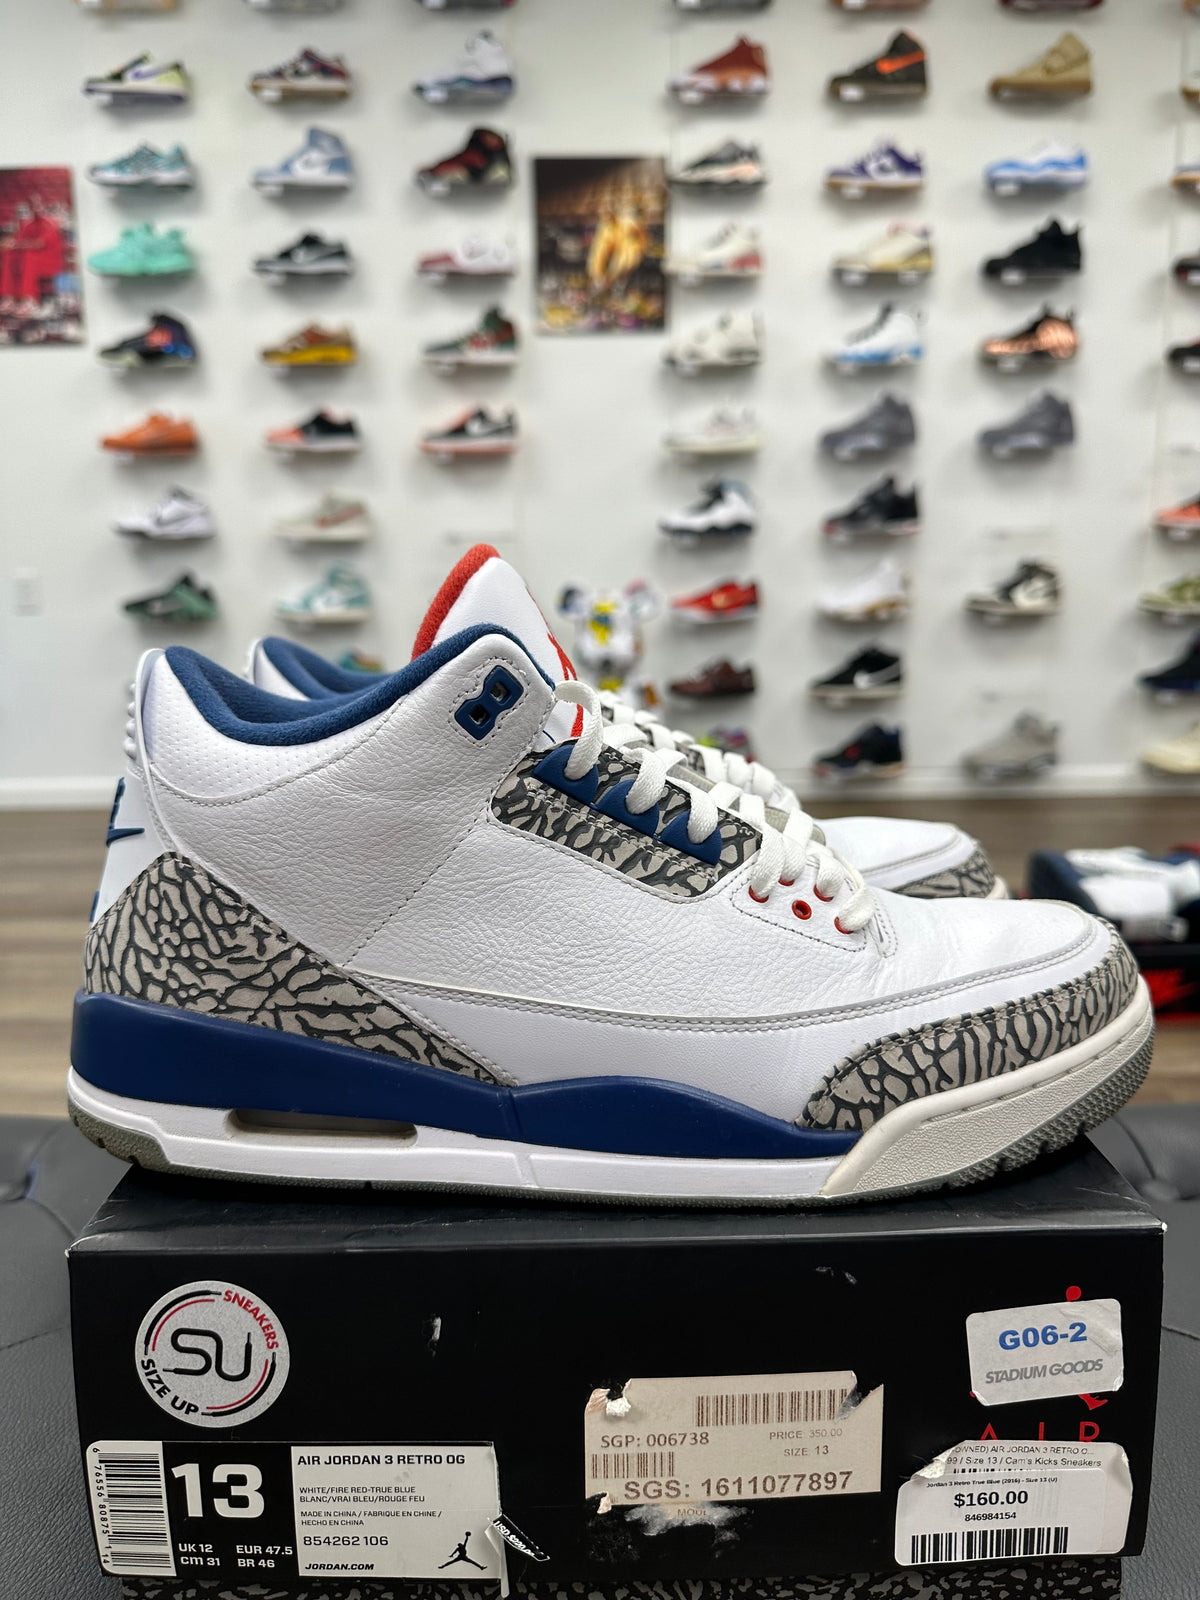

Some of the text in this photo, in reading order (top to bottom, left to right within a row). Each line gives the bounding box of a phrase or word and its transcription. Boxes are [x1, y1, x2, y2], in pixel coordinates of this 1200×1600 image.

[223, 1290, 279, 1350] SNEAKERS
[998, 1321, 1088, 1350] G06-2
[985, 1358, 1104, 1384] STADIUM GOODS
[141, 1358, 199, 1415] SIZE UP
[600, 1431, 710, 1449] SGP: 006738
[815, 1444, 829, 1455] 13
[1007, 1446, 1040, 1454] JORDAN
[297, 1454, 465, 1465] AIR JORDAN 3 RETRO OG
[965, 1456, 984, 1465] Size
[987, 1457, 998, 1465] 13
[1035, 1457, 1058, 1465] Kicks
[1061, 1458, 1102, 1467] Sneakers
[94, 1465, 105, 1498] 76556
[623, 1470, 853, 1500] SGS: 1611077897
[171, 1463, 265, 1519] 13
[352, 1495, 407, 1503] BLEU/ROUGE
[954, 1491, 1029, 1508] $160.00
[98, 1503, 110, 1535] 80875
[965, 1512, 1017, 1522] 846984154
[178, 1543, 213, 1553] UK 12
[236, 1545, 293, 1556] EUR 47.5
[206, 1557, 221, 1567] 31
[237, 1559, 276, 1568] BR 46
[304, 1563, 374, 1571] JORDAN.COM
